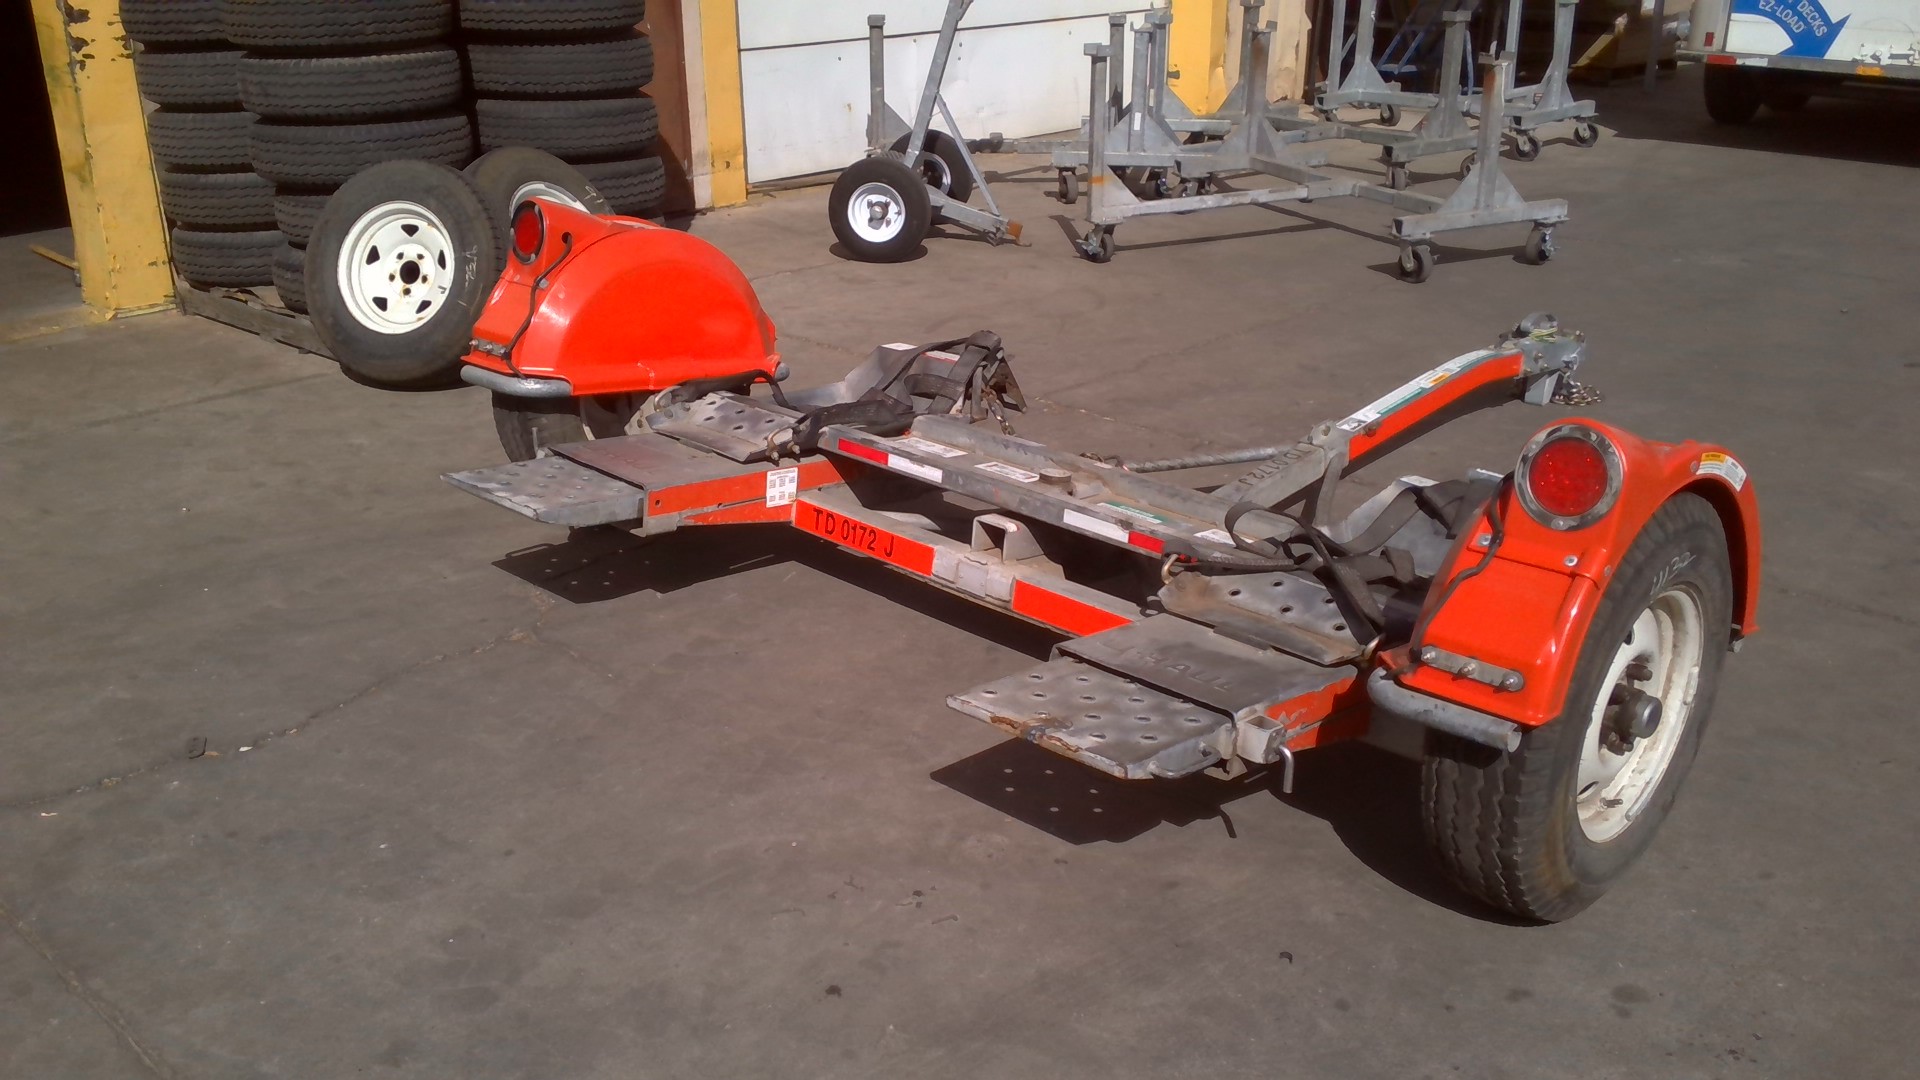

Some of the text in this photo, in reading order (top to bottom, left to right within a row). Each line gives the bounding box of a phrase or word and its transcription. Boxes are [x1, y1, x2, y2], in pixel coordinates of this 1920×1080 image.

[1759, 0, 1804, 33] EZ-LOAD
[1797, 0, 1827, 36] DECKS
[1246, 460, 1289, 480] 0172
[840, 519, 877, 552] 0172
[884, 535, 895, 558] J
